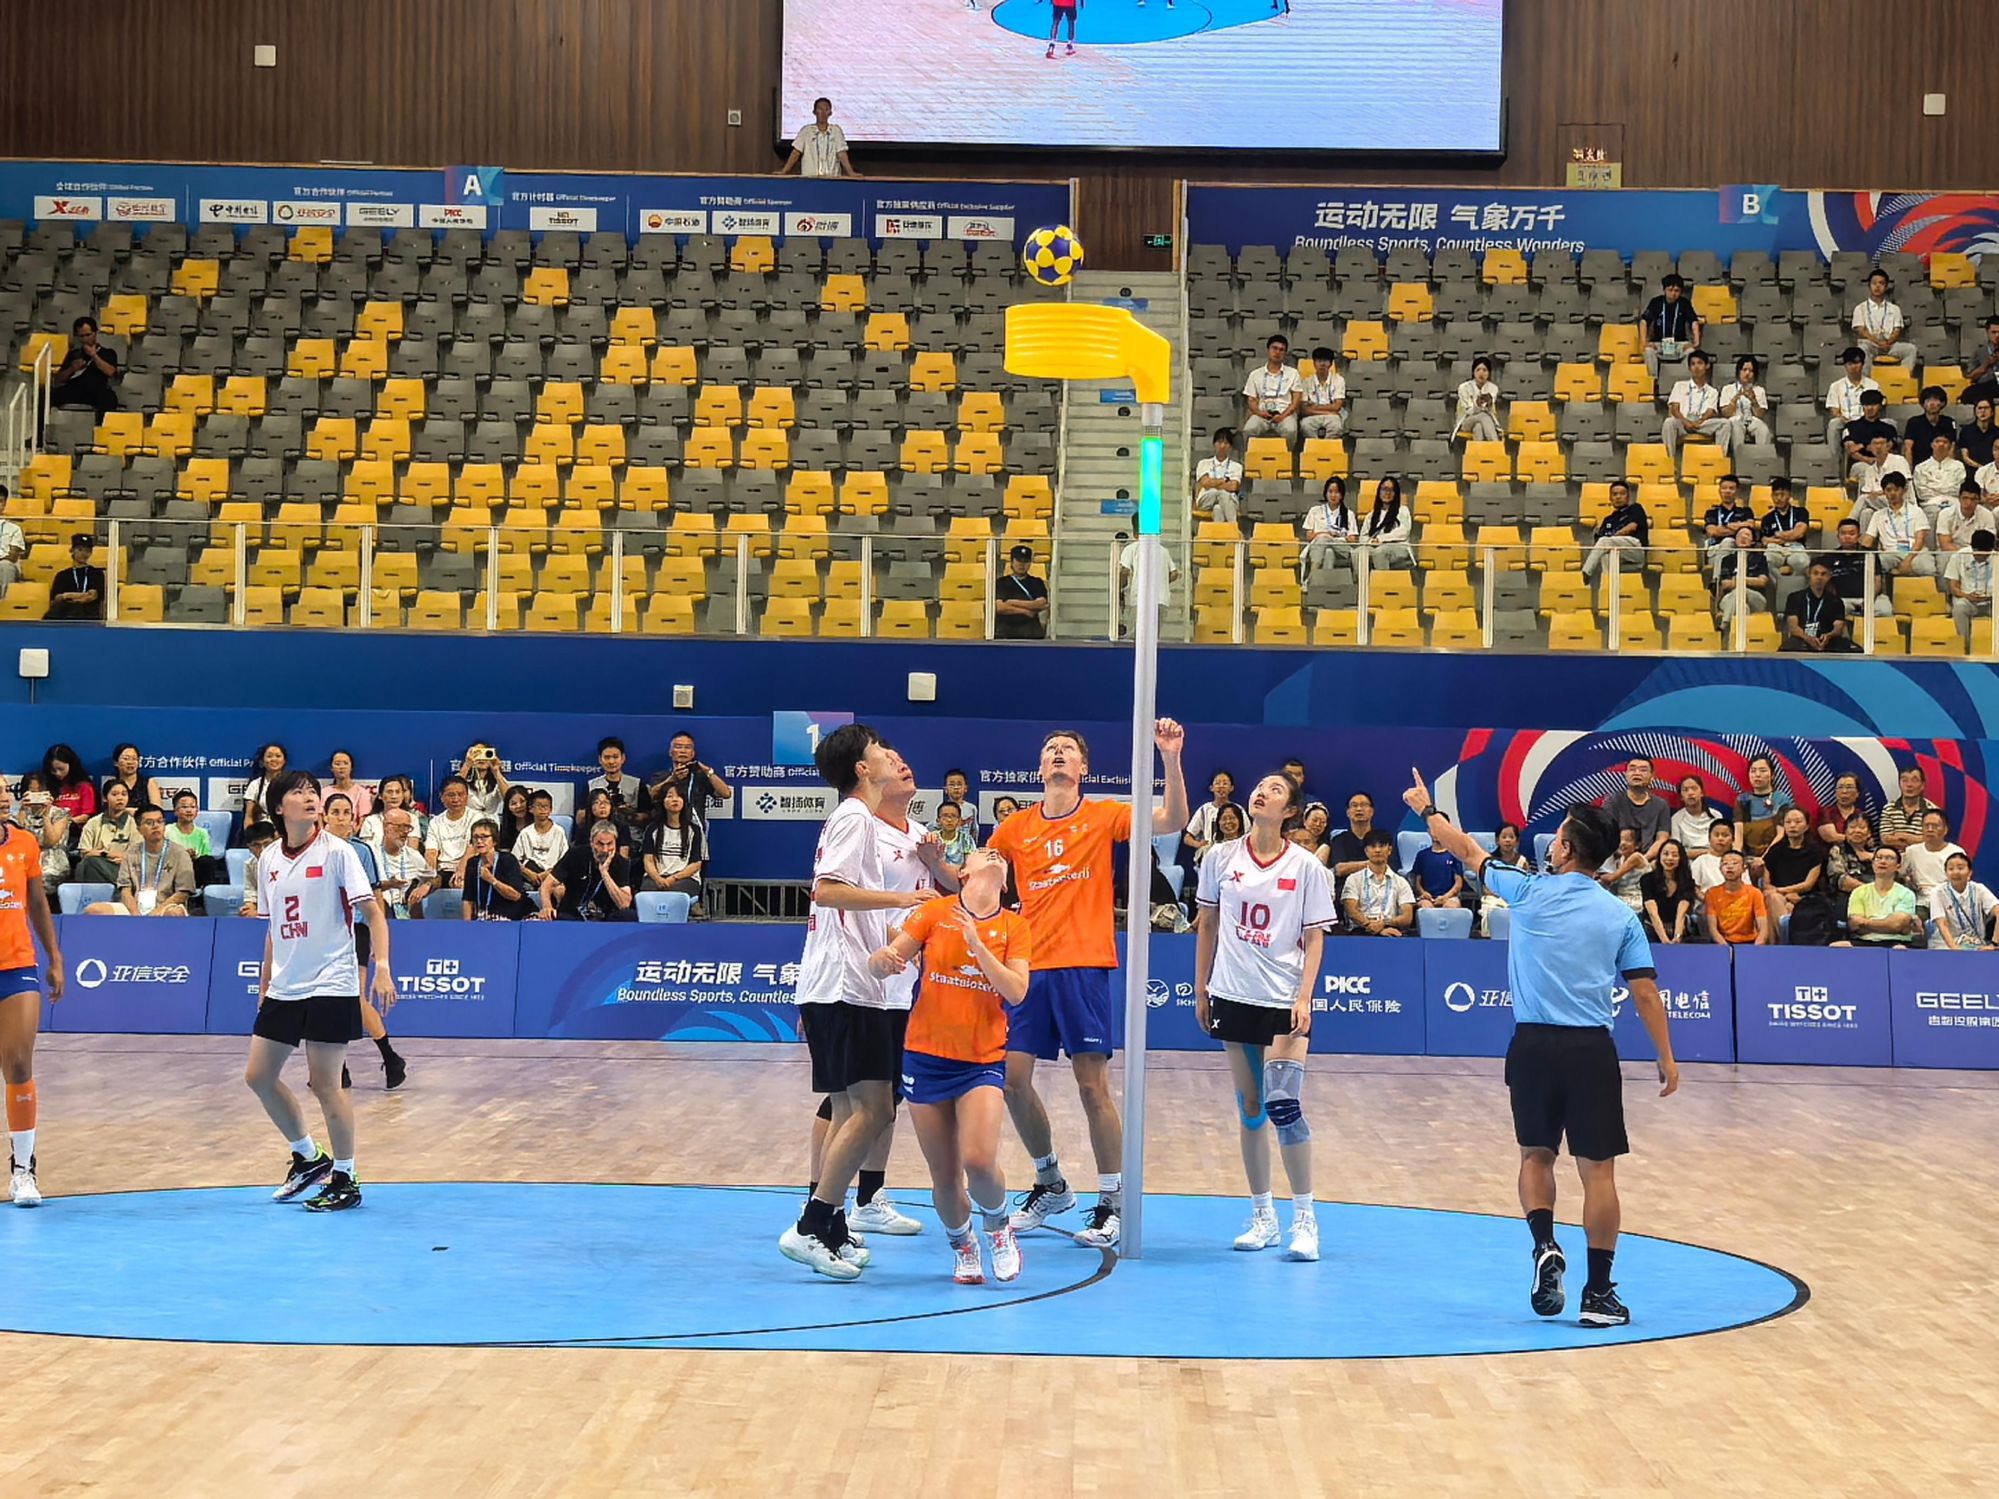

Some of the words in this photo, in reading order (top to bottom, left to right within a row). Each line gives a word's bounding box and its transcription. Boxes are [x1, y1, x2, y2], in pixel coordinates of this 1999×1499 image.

[464, 175, 483, 196] A
[1742, 194, 1760, 215] B
[1315, 201, 1438, 231] 运动无限
[1451, 202, 1565, 231] 气象万千
[209, 759, 242, 767] Official
[515, 762, 547, 772] Official
[724, 765, 785, 778] 官方赞助商
[980, 770, 1044, 784] 官方独家供
[1101, 775, 1132, 785] Exclusi
[780, 796, 826, 809] 智扬体育
[1044, 839, 1064, 859] 16
[284, 895, 300, 922] 2
[1239, 901, 1271, 931] 10
[280, 921, 308, 940] CHN
[109, 965, 191, 983] 亚信安全
[635, 960, 742, 985] 运动无限
[398, 976, 485, 993] TISSOT
[1325, 975, 1371, 994] PICC
[617, 988, 686, 1003] Boundless
[689, 989, 735, 1006] Sports,
[739, 991, 797, 1004] Countles
[1308, 998, 1402, 1013] 国人民保险
[1479, 989, 1513, 1007] 亚信
[1657, 989, 1710, 1010] 国电信
[1916, 992, 1999, 1010] GEEL
[1667, 1010, 1711, 1019] TELECOM
[1767, 1003, 1857, 1021] TISSOT
